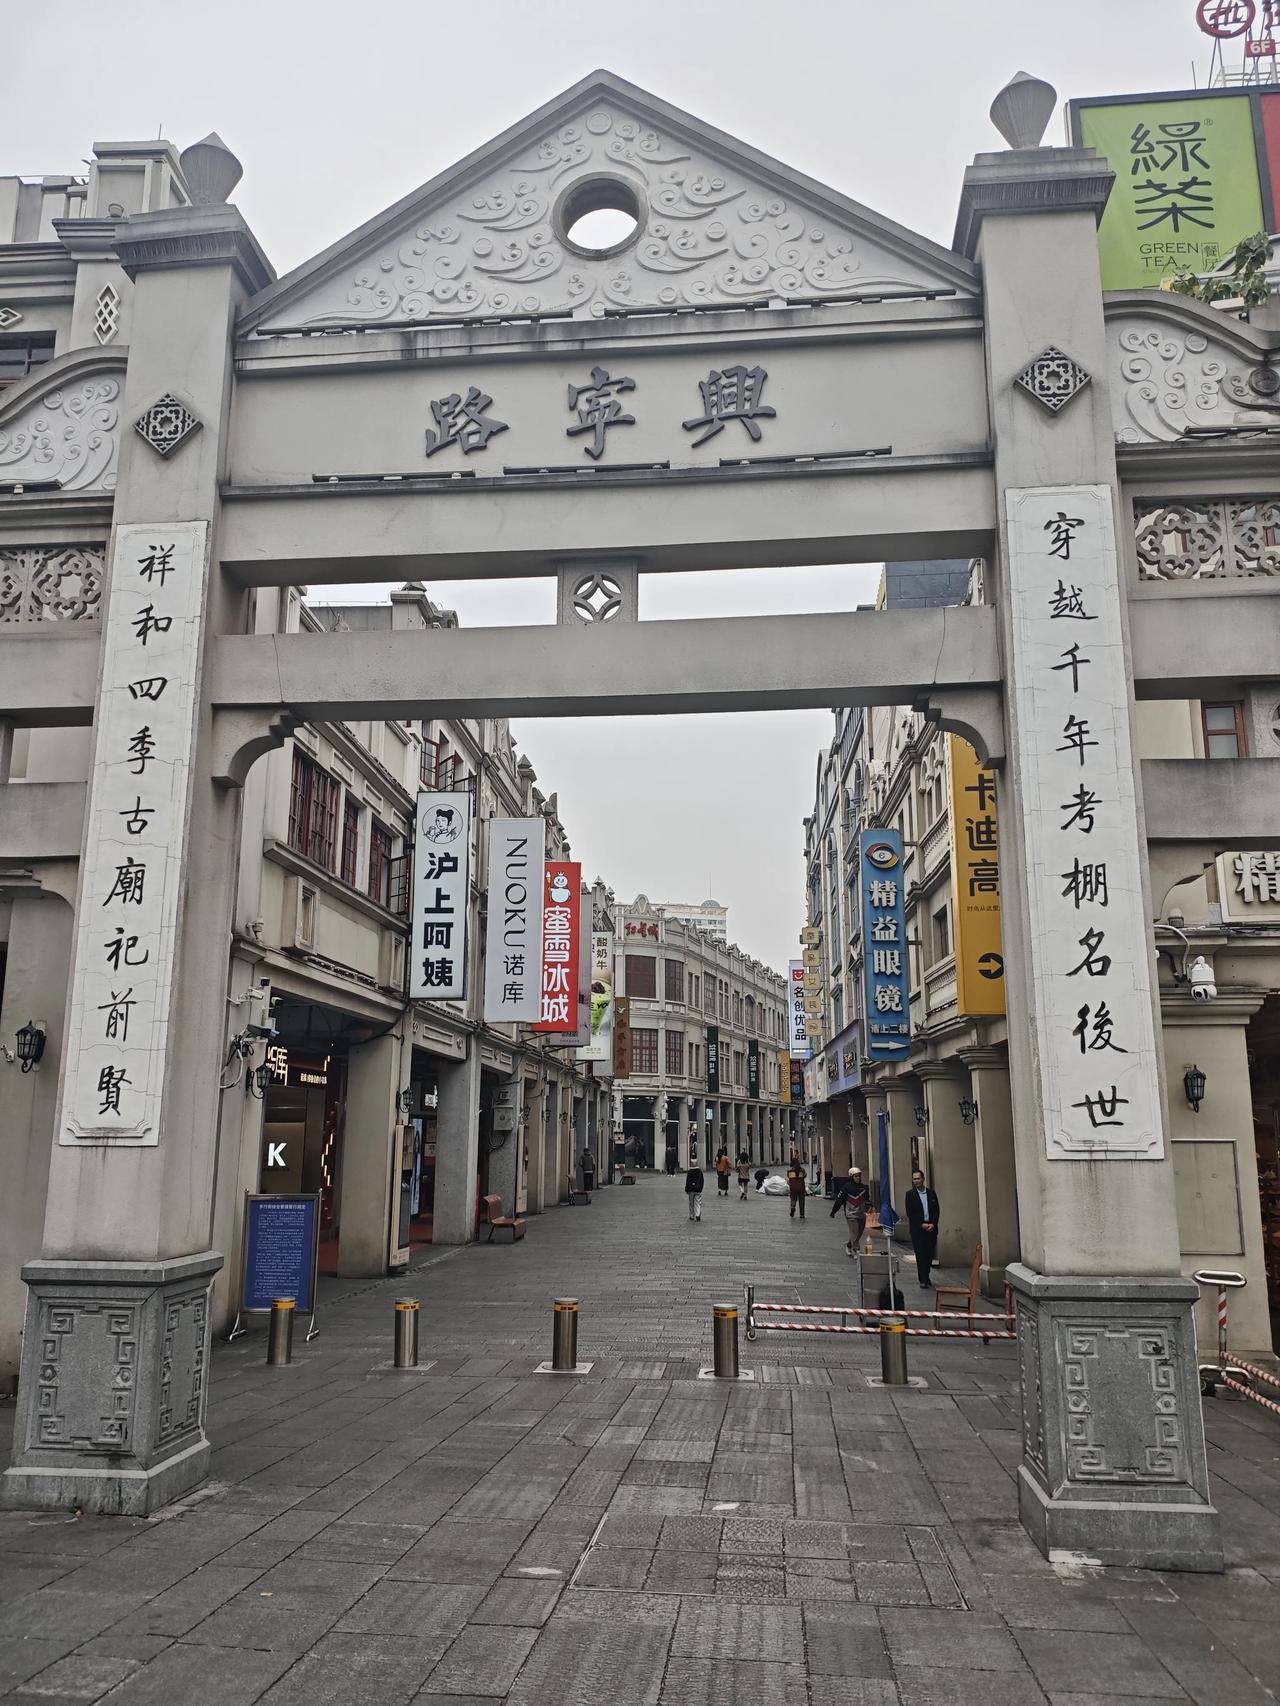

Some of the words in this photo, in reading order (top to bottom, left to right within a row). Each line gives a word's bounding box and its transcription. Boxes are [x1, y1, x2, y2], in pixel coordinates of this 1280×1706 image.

[1249, 40, 1271, 54] 6F
[1139, 242, 1199, 255] GREEN
[1141, 255, 1178, 268] TEA
[503, 837, 528, 949] NUOKU
[420, 851, 459, 988] 沪上阿姨
[541, 905, 572, 1023] 蜜雪冰城
[596, 936, 608, 970] 酸奶牛
[869, 879, 904, 1013] 精益眼镜
[501, 953, 526, 1005] 诺库
[793, 986, 807, 1041] 名创优品
[870, 1023, 909, 1034] 请上二楼
[266, 1142, 288, 1167] K
